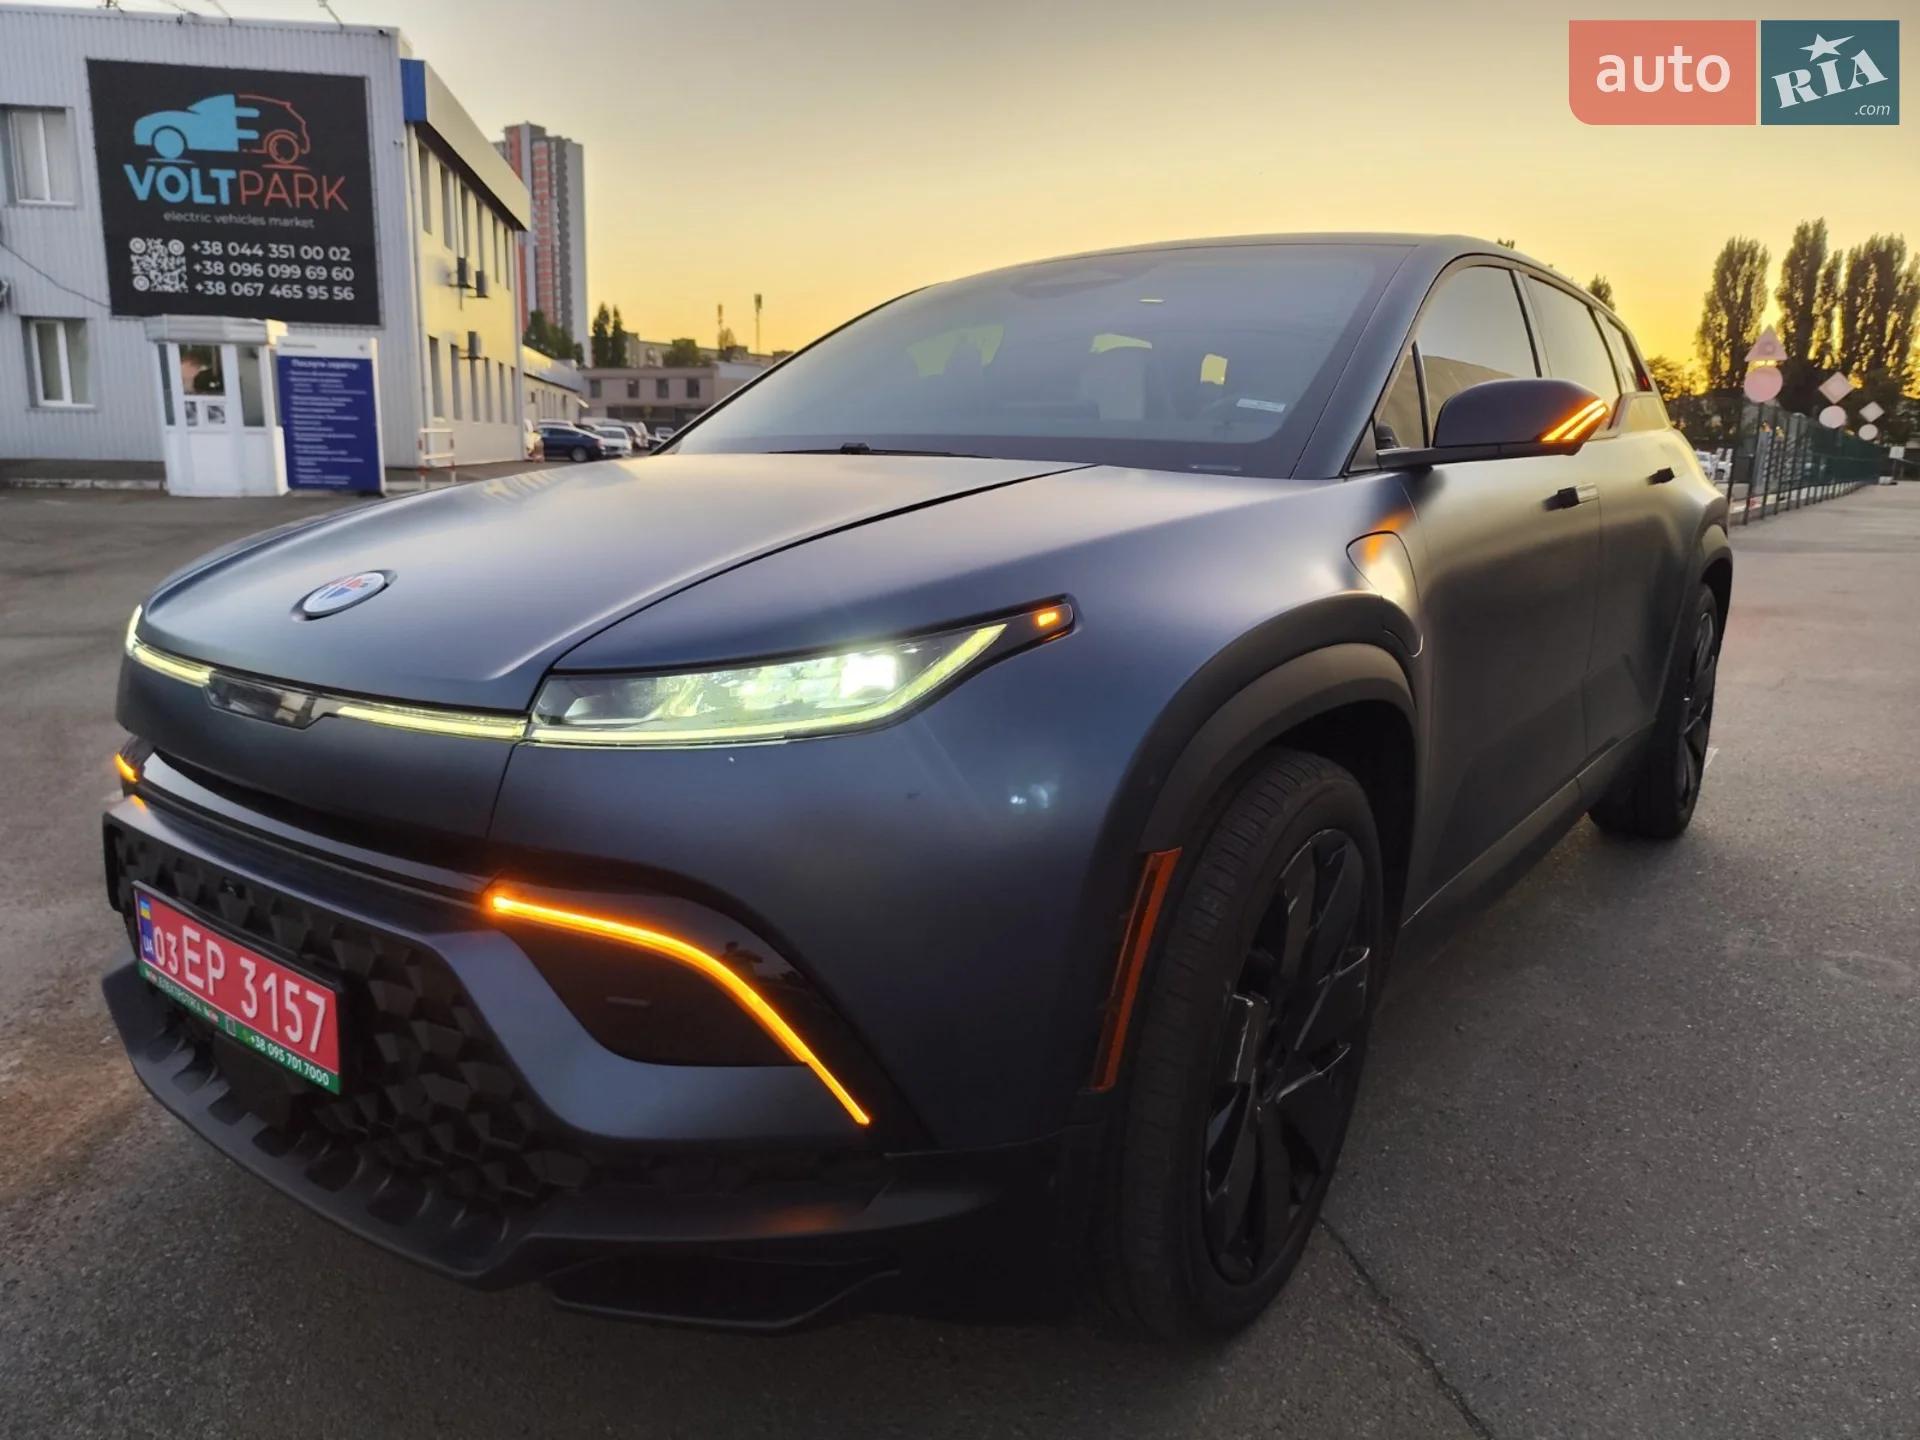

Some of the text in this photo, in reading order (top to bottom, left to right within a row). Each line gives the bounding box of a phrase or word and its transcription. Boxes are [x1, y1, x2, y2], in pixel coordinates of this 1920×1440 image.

[163, 211, 315, 229] electric vehicles market
[192, 240, 352, 262] +38 044 351 00 02
[193, 260, 355, 282] +38 096 099 69 60
[195, 280, 355, 301] +38 067 465 95 56
[239, 956, 326, 1054] 3157
[267, 1042, 285, 1062] 095
[286, 1052, 302, 1073] 701
[304, 1062, 330, 1086] 7000
